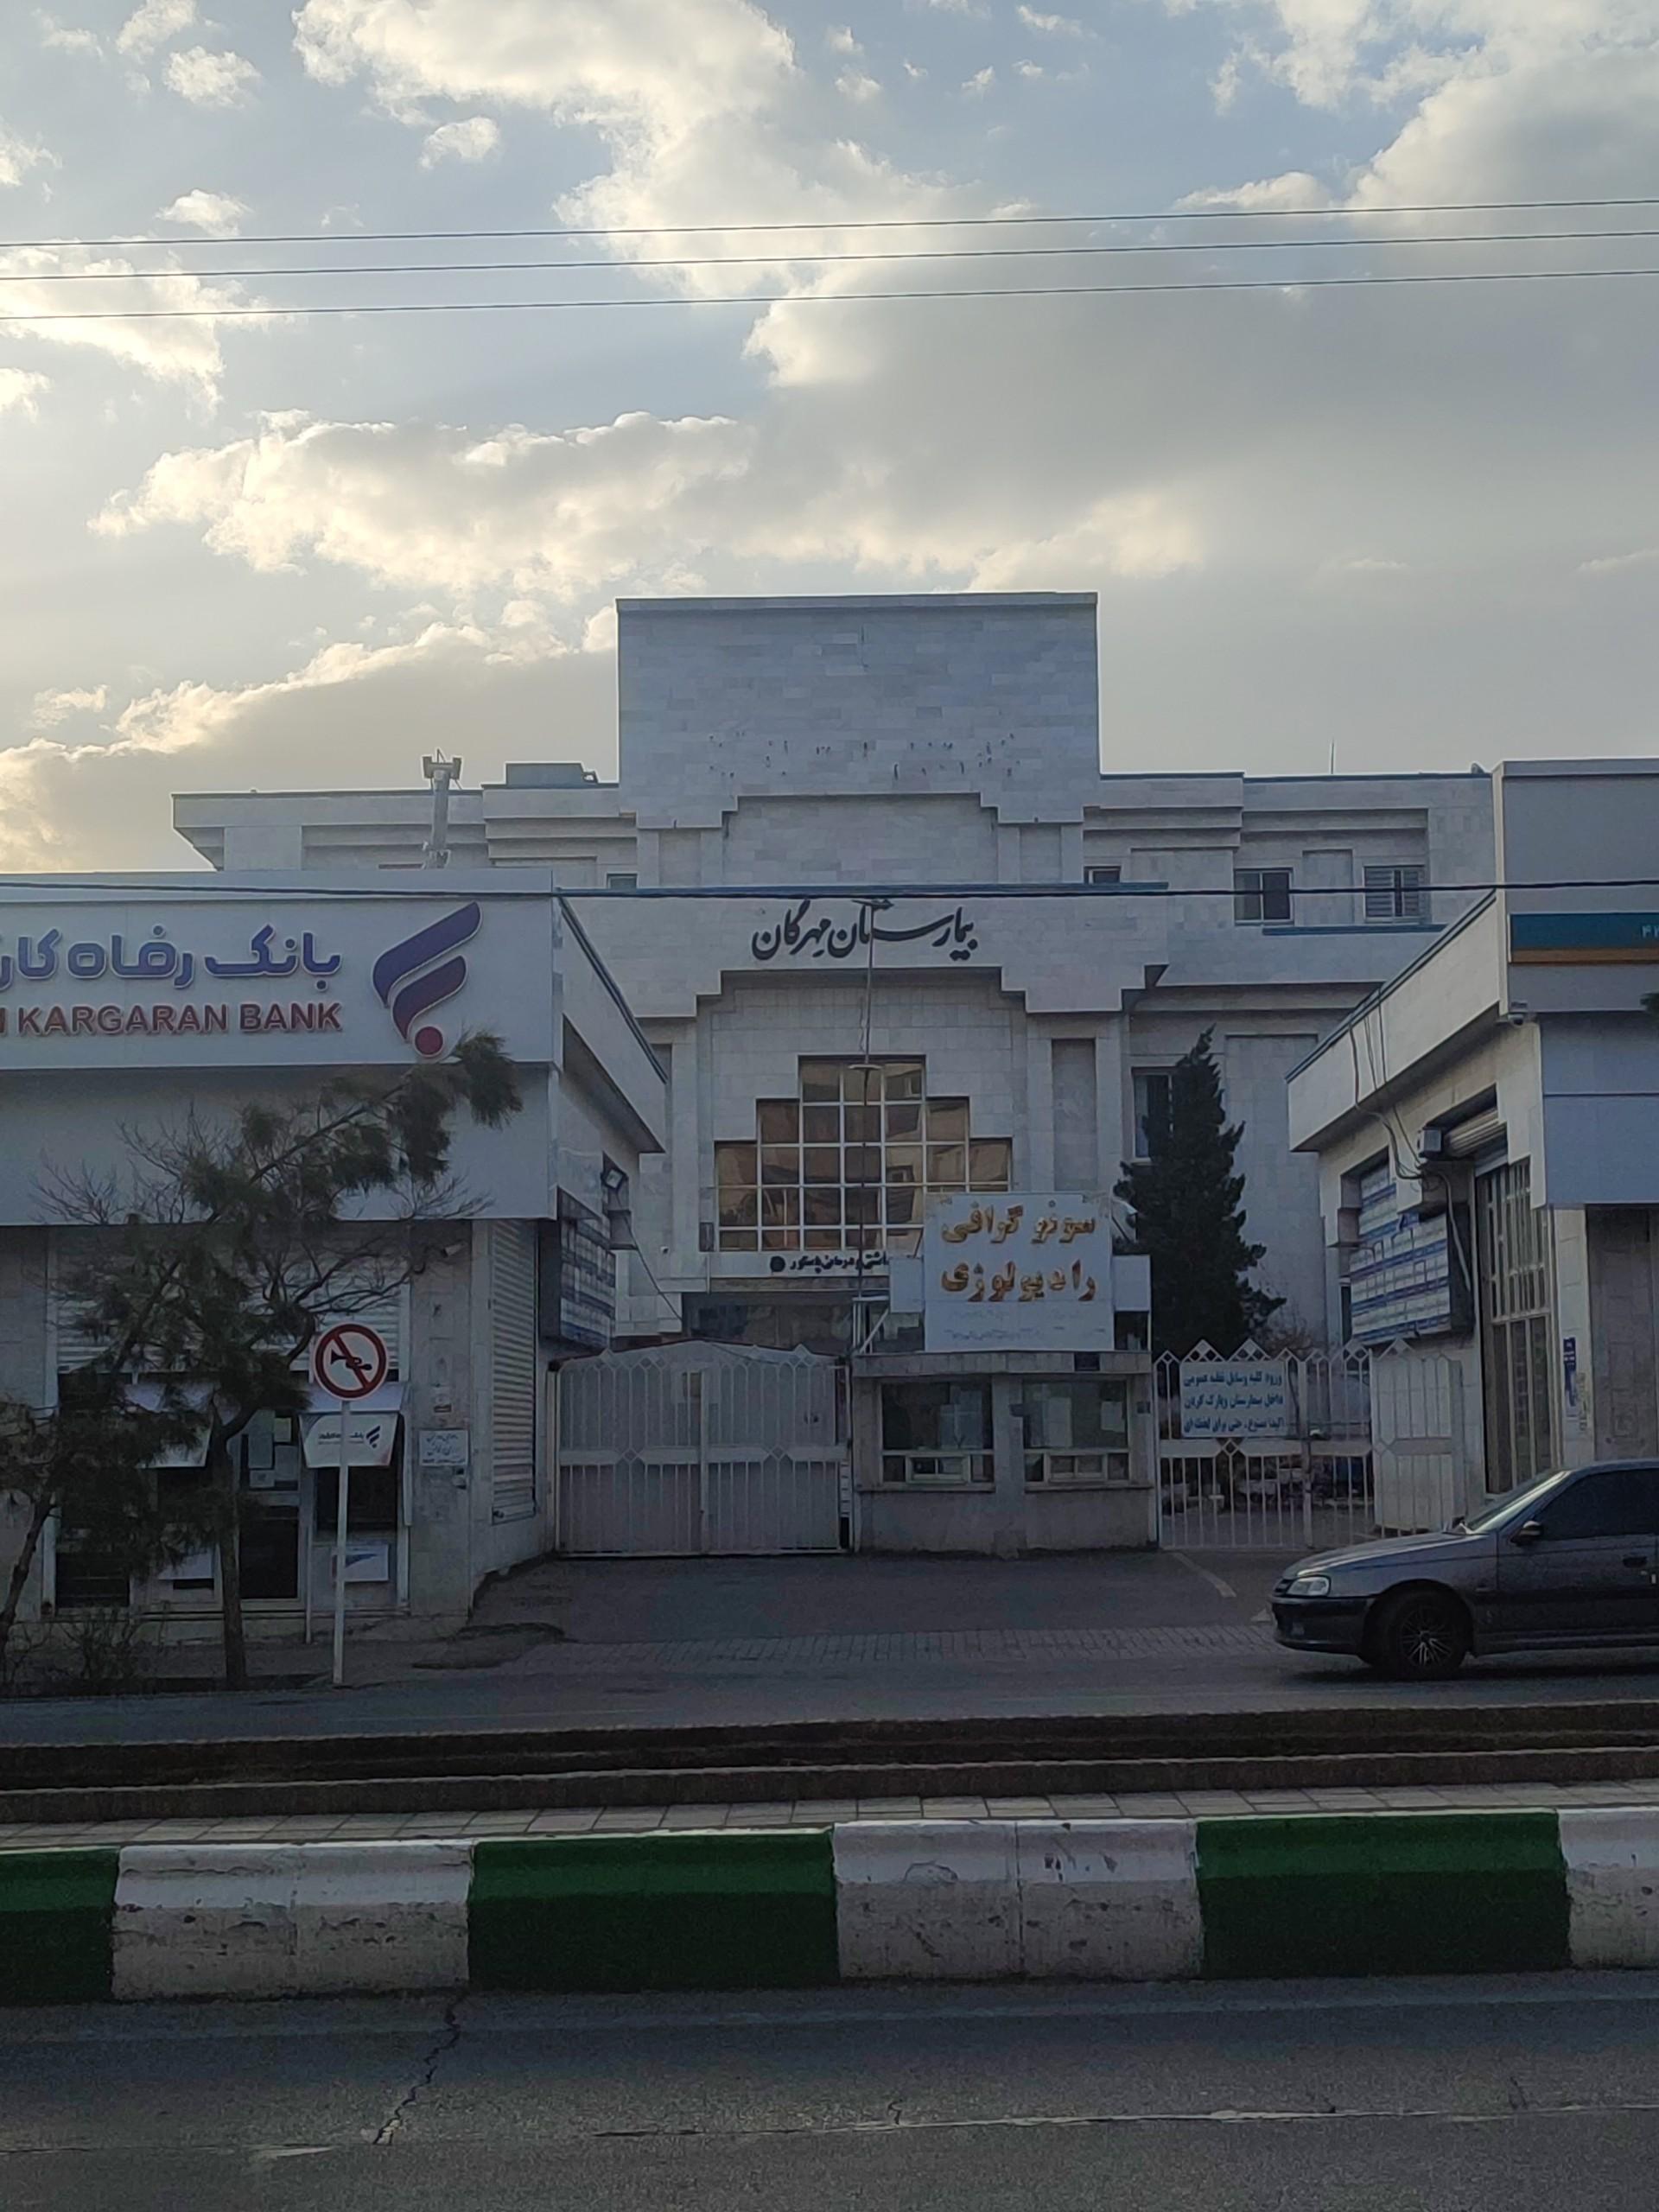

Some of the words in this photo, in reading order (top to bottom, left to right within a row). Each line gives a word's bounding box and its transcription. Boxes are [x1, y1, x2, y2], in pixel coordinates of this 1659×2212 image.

[67, 925, 195, 989] رفاه
[205, 925, 341, 991] بانک
[828, 899, 979, 961] بیمارستان
[18, 1004, 228, 1035] KARGARAN
[239, 1002, 342, 1033] BANK
[941, 1259, 1096, 1302] رادیولوژی
